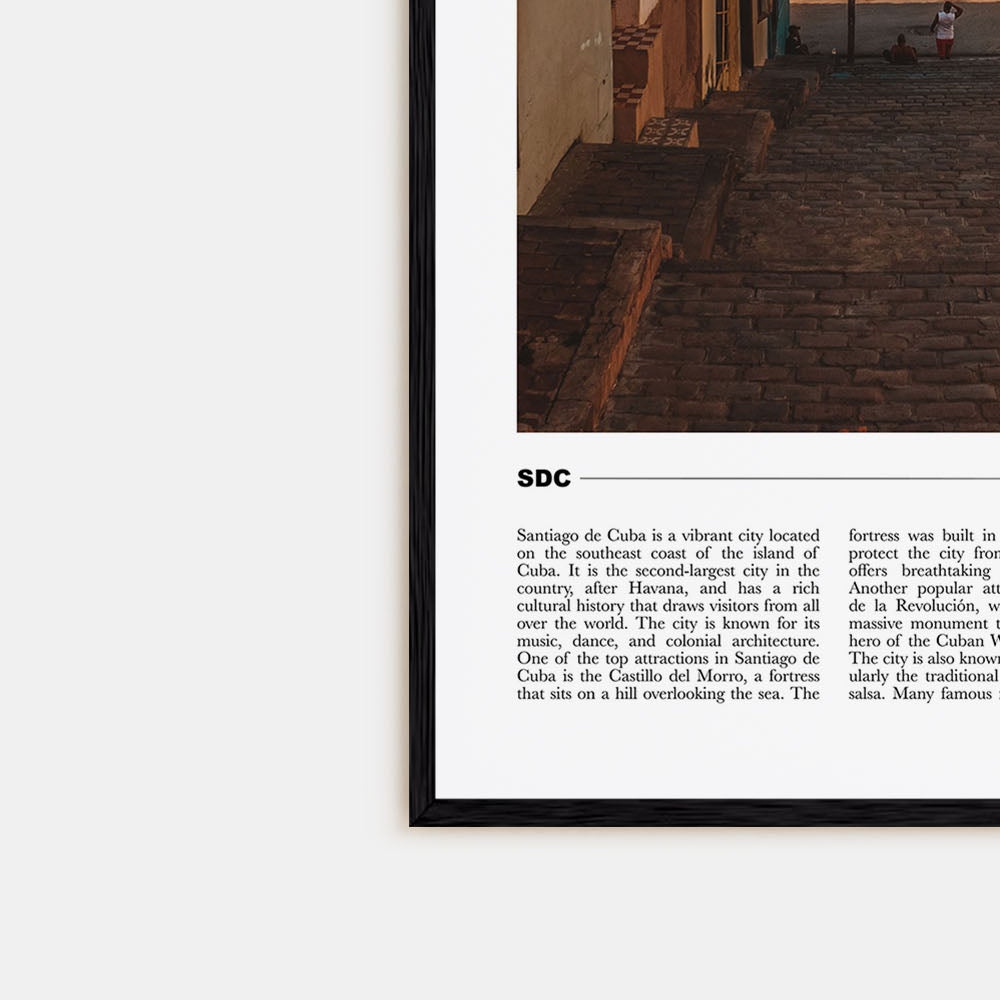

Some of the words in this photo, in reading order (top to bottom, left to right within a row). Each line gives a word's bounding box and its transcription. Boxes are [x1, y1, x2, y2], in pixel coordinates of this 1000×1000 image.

[517, 469, 571, 487] SDC
[516, 528, 580, 546] Santiago
[584, 528, 602, 542] de
[606, 528, 647, 542] Cuba
[651, 529, 663, 541] is
[667, 532, 677, 541] a
[681, 529, 733, 542] vibrant
[737, 529, 764, 545] city
[769, 528, 820, 542] located
[848, 549, 899, 563] protect
[907, 546, 931, 559] the
[939, 547, 966, 563] city
[516, 563, 561, 577] Cuba.
[568, 564, 581, 576] It
[587, 564, 599, 577] is
[605, 564, 629, 577] the
[635, 564, 736, 581] second-largest
[742, 564, 769, 580] city
[775, 564, 790, 576] in
[797, 564, 820, 577] the
[848, 563, 888, 577] offers
[901, 564, 992, 581] breathtaking
[516, 584, 574, 598] country,
[584, 581, 619, 594] after
[628, 581, 689, 597] Havana,
[699, 581, 727, 594] and
[737, 581, 762, 594] has
[772, 585, 782, 594] a
[792, 581, 820, 594] rich
[848, 581, 909, 594] Another
[917, 581, 974, 598] popular
[516, 599, 572, 612] cultural
[576, 599, 626, 615] history
[629, 599, 658, 612] that
[662, 599, 705, 612] draws
[709, 599, 760, 612] visitors
[763, 598, 798, 612] from
[802, 599, 820, 612] all
[848, 599, 866, 612] de
[874, 599, 888, 612] la
[895, 598, 980, 614] Revolución,
[848, 617, 903, 629] massive
[910, 620, 989, 629] monument
[516, 635, 563, 650] music,
[572, 634, 619, 650] dance,
[628, 634, 656, 647] and
[665, 634, 722, 647] colonial
[731, 634, 820, 647] architecture.
[516, 651, 549, 664] One
[554, 651, 572, 664] of
[576, 651, 600, 664] the
[605, 655, 629, 668] top
[634, 652, 710, 664] attractions
[714, 652, 729, 664] in
[734, 651, 797, 668] Santiago
[802, 651, 821, 664] de
[516, 669, 557, 682] Cuba
[562, 670, 574, 682] is
[580, 669, 603, 682] the
[608, 669, 663, 682] Castillo
[668, 669, 691, 682] del
[696, 669, 748, 685] Morro,
[753, 673, 763, 682] a
[769, 669, 821, 682] fortress
[848, 669, 890, 686] ularly
[895, 669, 919, 682] the
[925, 669, 999, 682] traditional
[848, 687, 886, 700] salsa.
[892, 687, 935, 703] Many
[940, 686, 993, 700] famous
